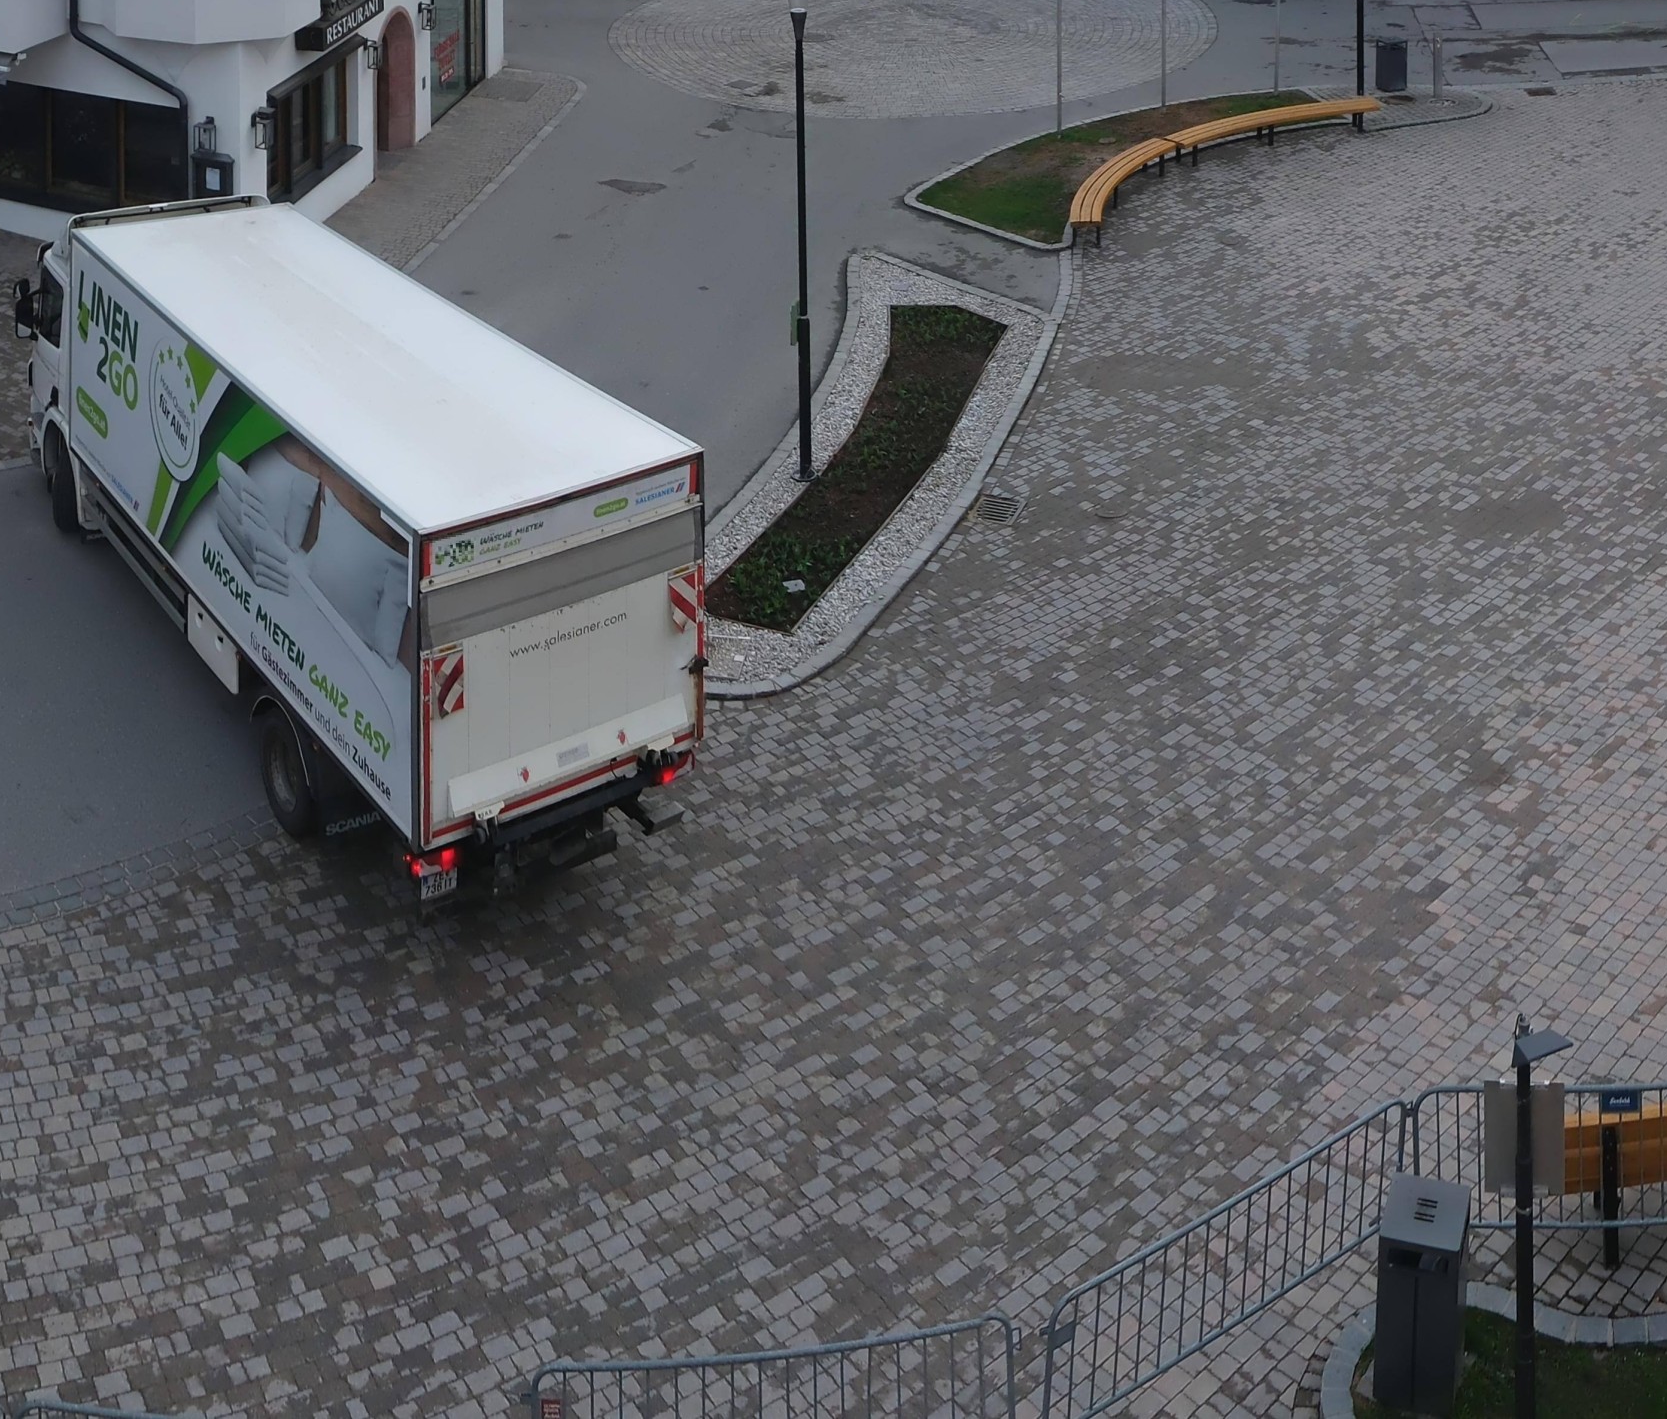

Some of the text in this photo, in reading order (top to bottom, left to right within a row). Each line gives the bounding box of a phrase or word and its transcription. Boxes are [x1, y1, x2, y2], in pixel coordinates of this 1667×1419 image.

[78, 270, 139, 364] LINEN
[97, 336, 139, 411] 2GO
[160, 393, 188, 452] für Alle!
[635, 486, 676, 506] SALESIANER
[480, 521, 544, 546] WÄSCHE MIETEN
[203, 541, 390, 762] WÄSCHE MIETEN GANZ EASY
[510, 614, 628, 659] www.salesianer.com
[250, 632, 391, 801] für Gästezimmer und dein Zuhause
[325, 810, 381, 838] SCANIA
